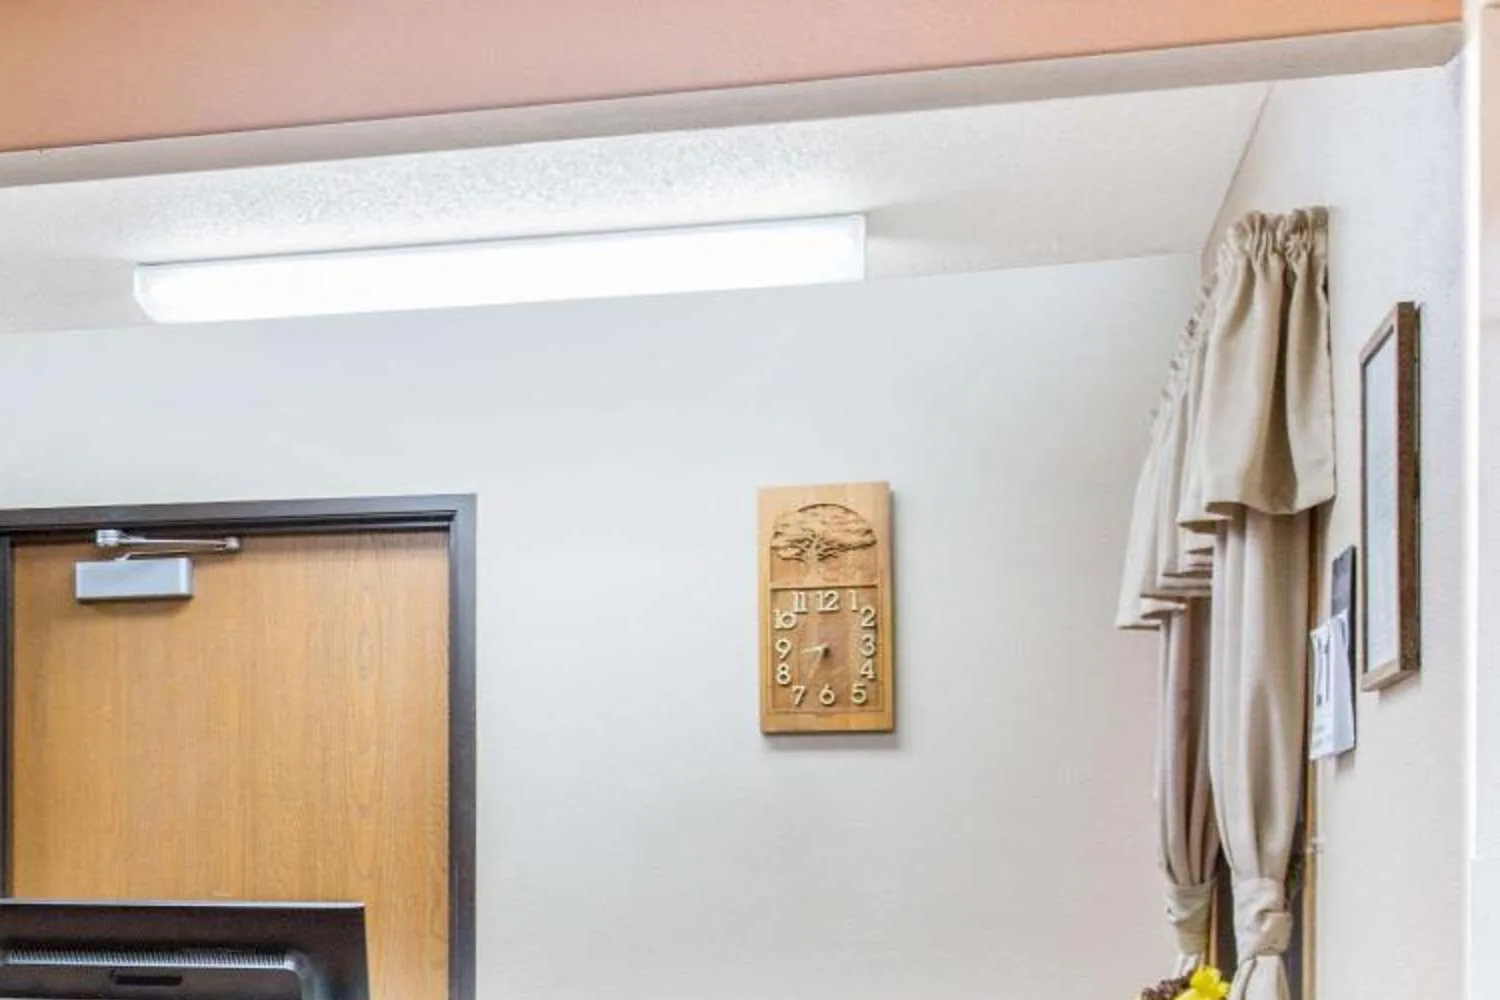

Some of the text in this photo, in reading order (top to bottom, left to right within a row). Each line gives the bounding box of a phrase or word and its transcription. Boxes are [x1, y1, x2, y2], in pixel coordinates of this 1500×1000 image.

[792, 591, 808, 613] 11
[815, 590, 841, 612] 12
[848, 590, 859, 612] 1
[772, 608, 797, 630] 10
[860, 605, 876, 628] 2
[775, 638, 792, 660] 9
[860, 635, 876, 658] 3
[776, 663, 792, 686] 8
[860, 660, 876, 681] 4
[791, 685, 806, 706] 7
[819, 684, 836, 706] 6
[851, 682, 867, 705] 5
